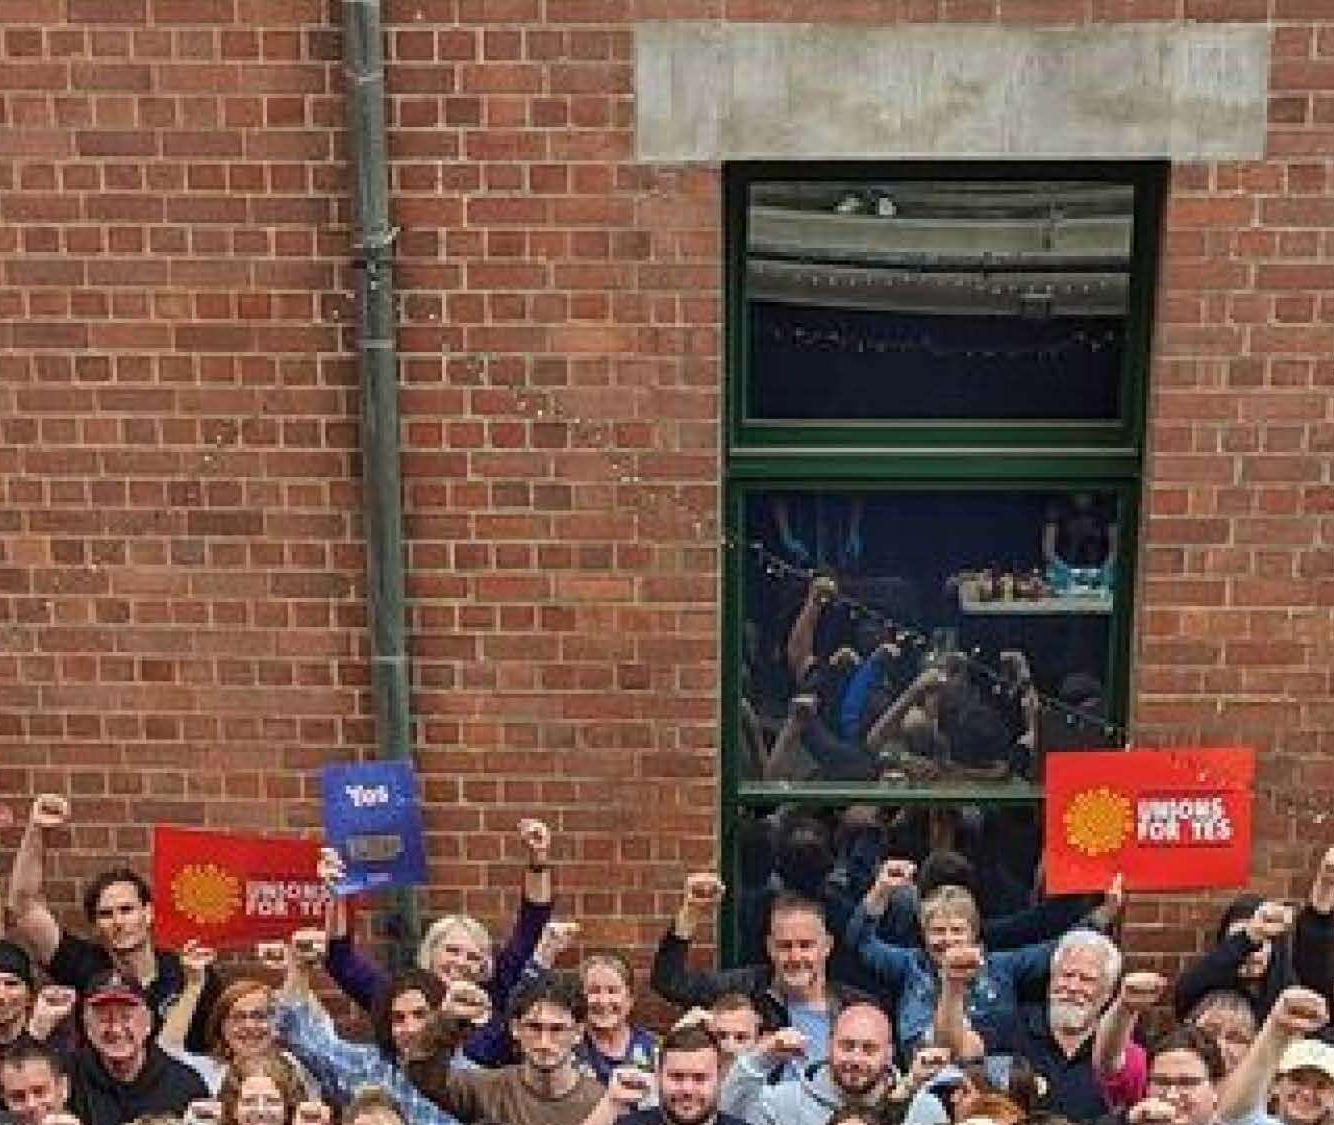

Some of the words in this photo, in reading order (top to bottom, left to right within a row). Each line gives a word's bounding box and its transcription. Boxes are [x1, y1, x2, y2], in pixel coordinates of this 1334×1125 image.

[1137, 797, 1227, 820] UNIONS
[1137, 818, 1181, 841] FOR
[1192, 819, 1235, 841] YES
